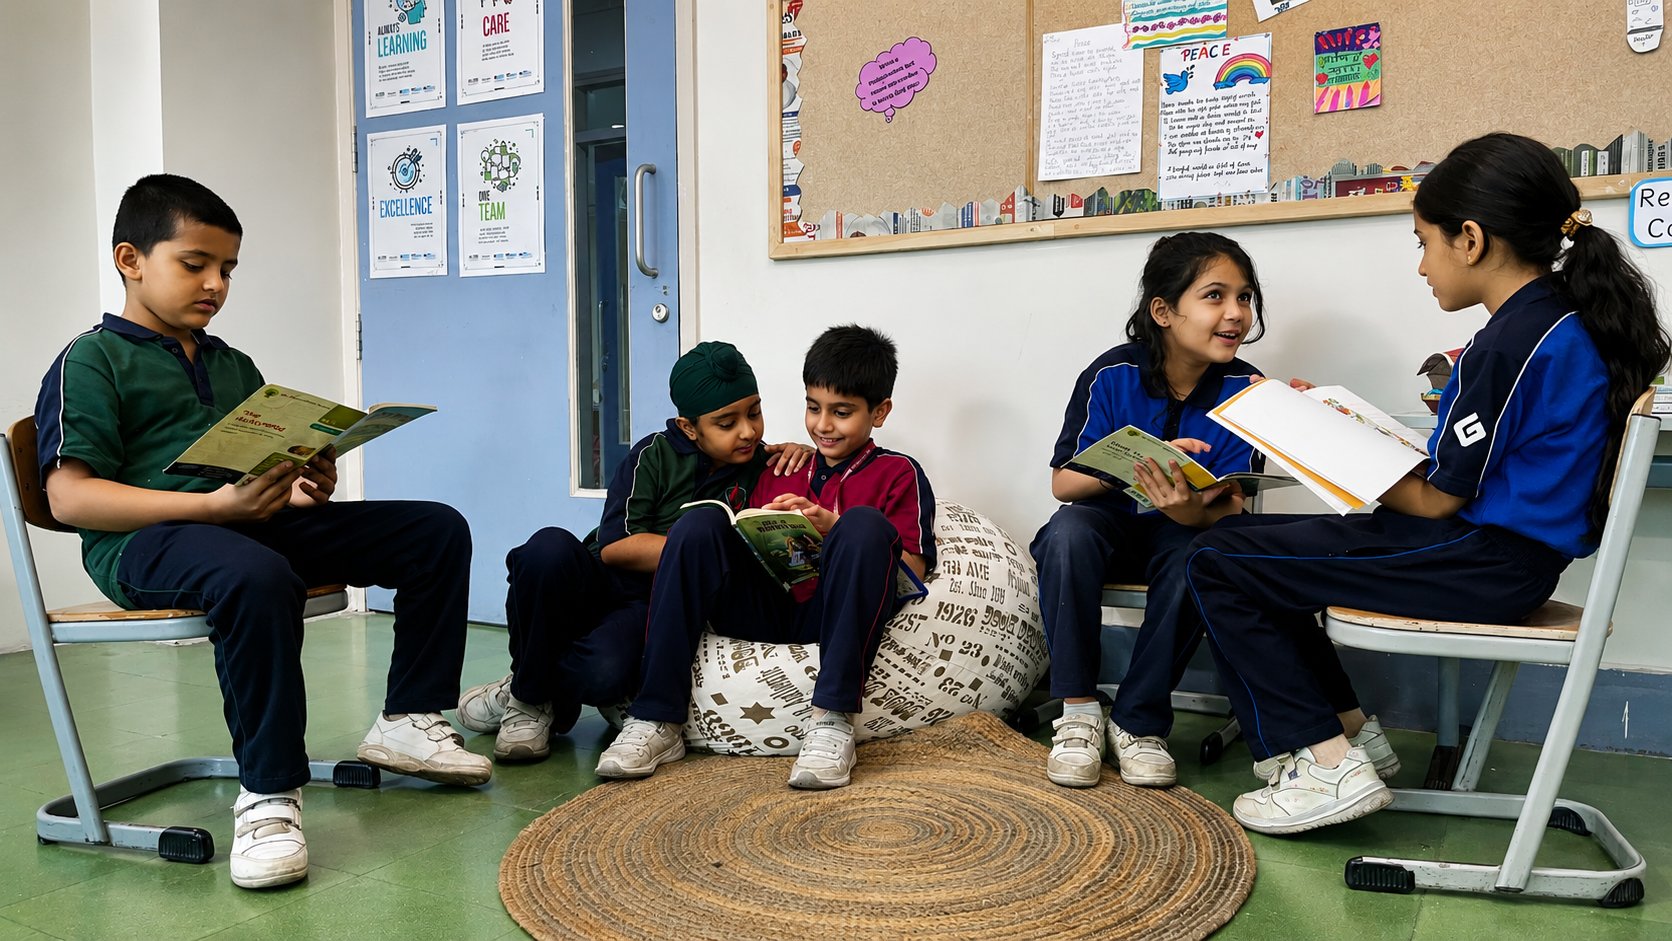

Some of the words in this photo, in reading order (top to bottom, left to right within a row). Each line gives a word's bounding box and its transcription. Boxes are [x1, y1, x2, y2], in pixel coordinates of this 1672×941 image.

[483, 12, 510, 37] CARE
[378, 30, 427, 58] LEARNING
[1180, 43, 1231, 62] PEACE
[380, 196, 433, 218] EXCELLENCE
[1640, 188, 1670, 208] Re
[478, 201, 506, 221] TEAM
[1453, 412, 1487, 447] G
